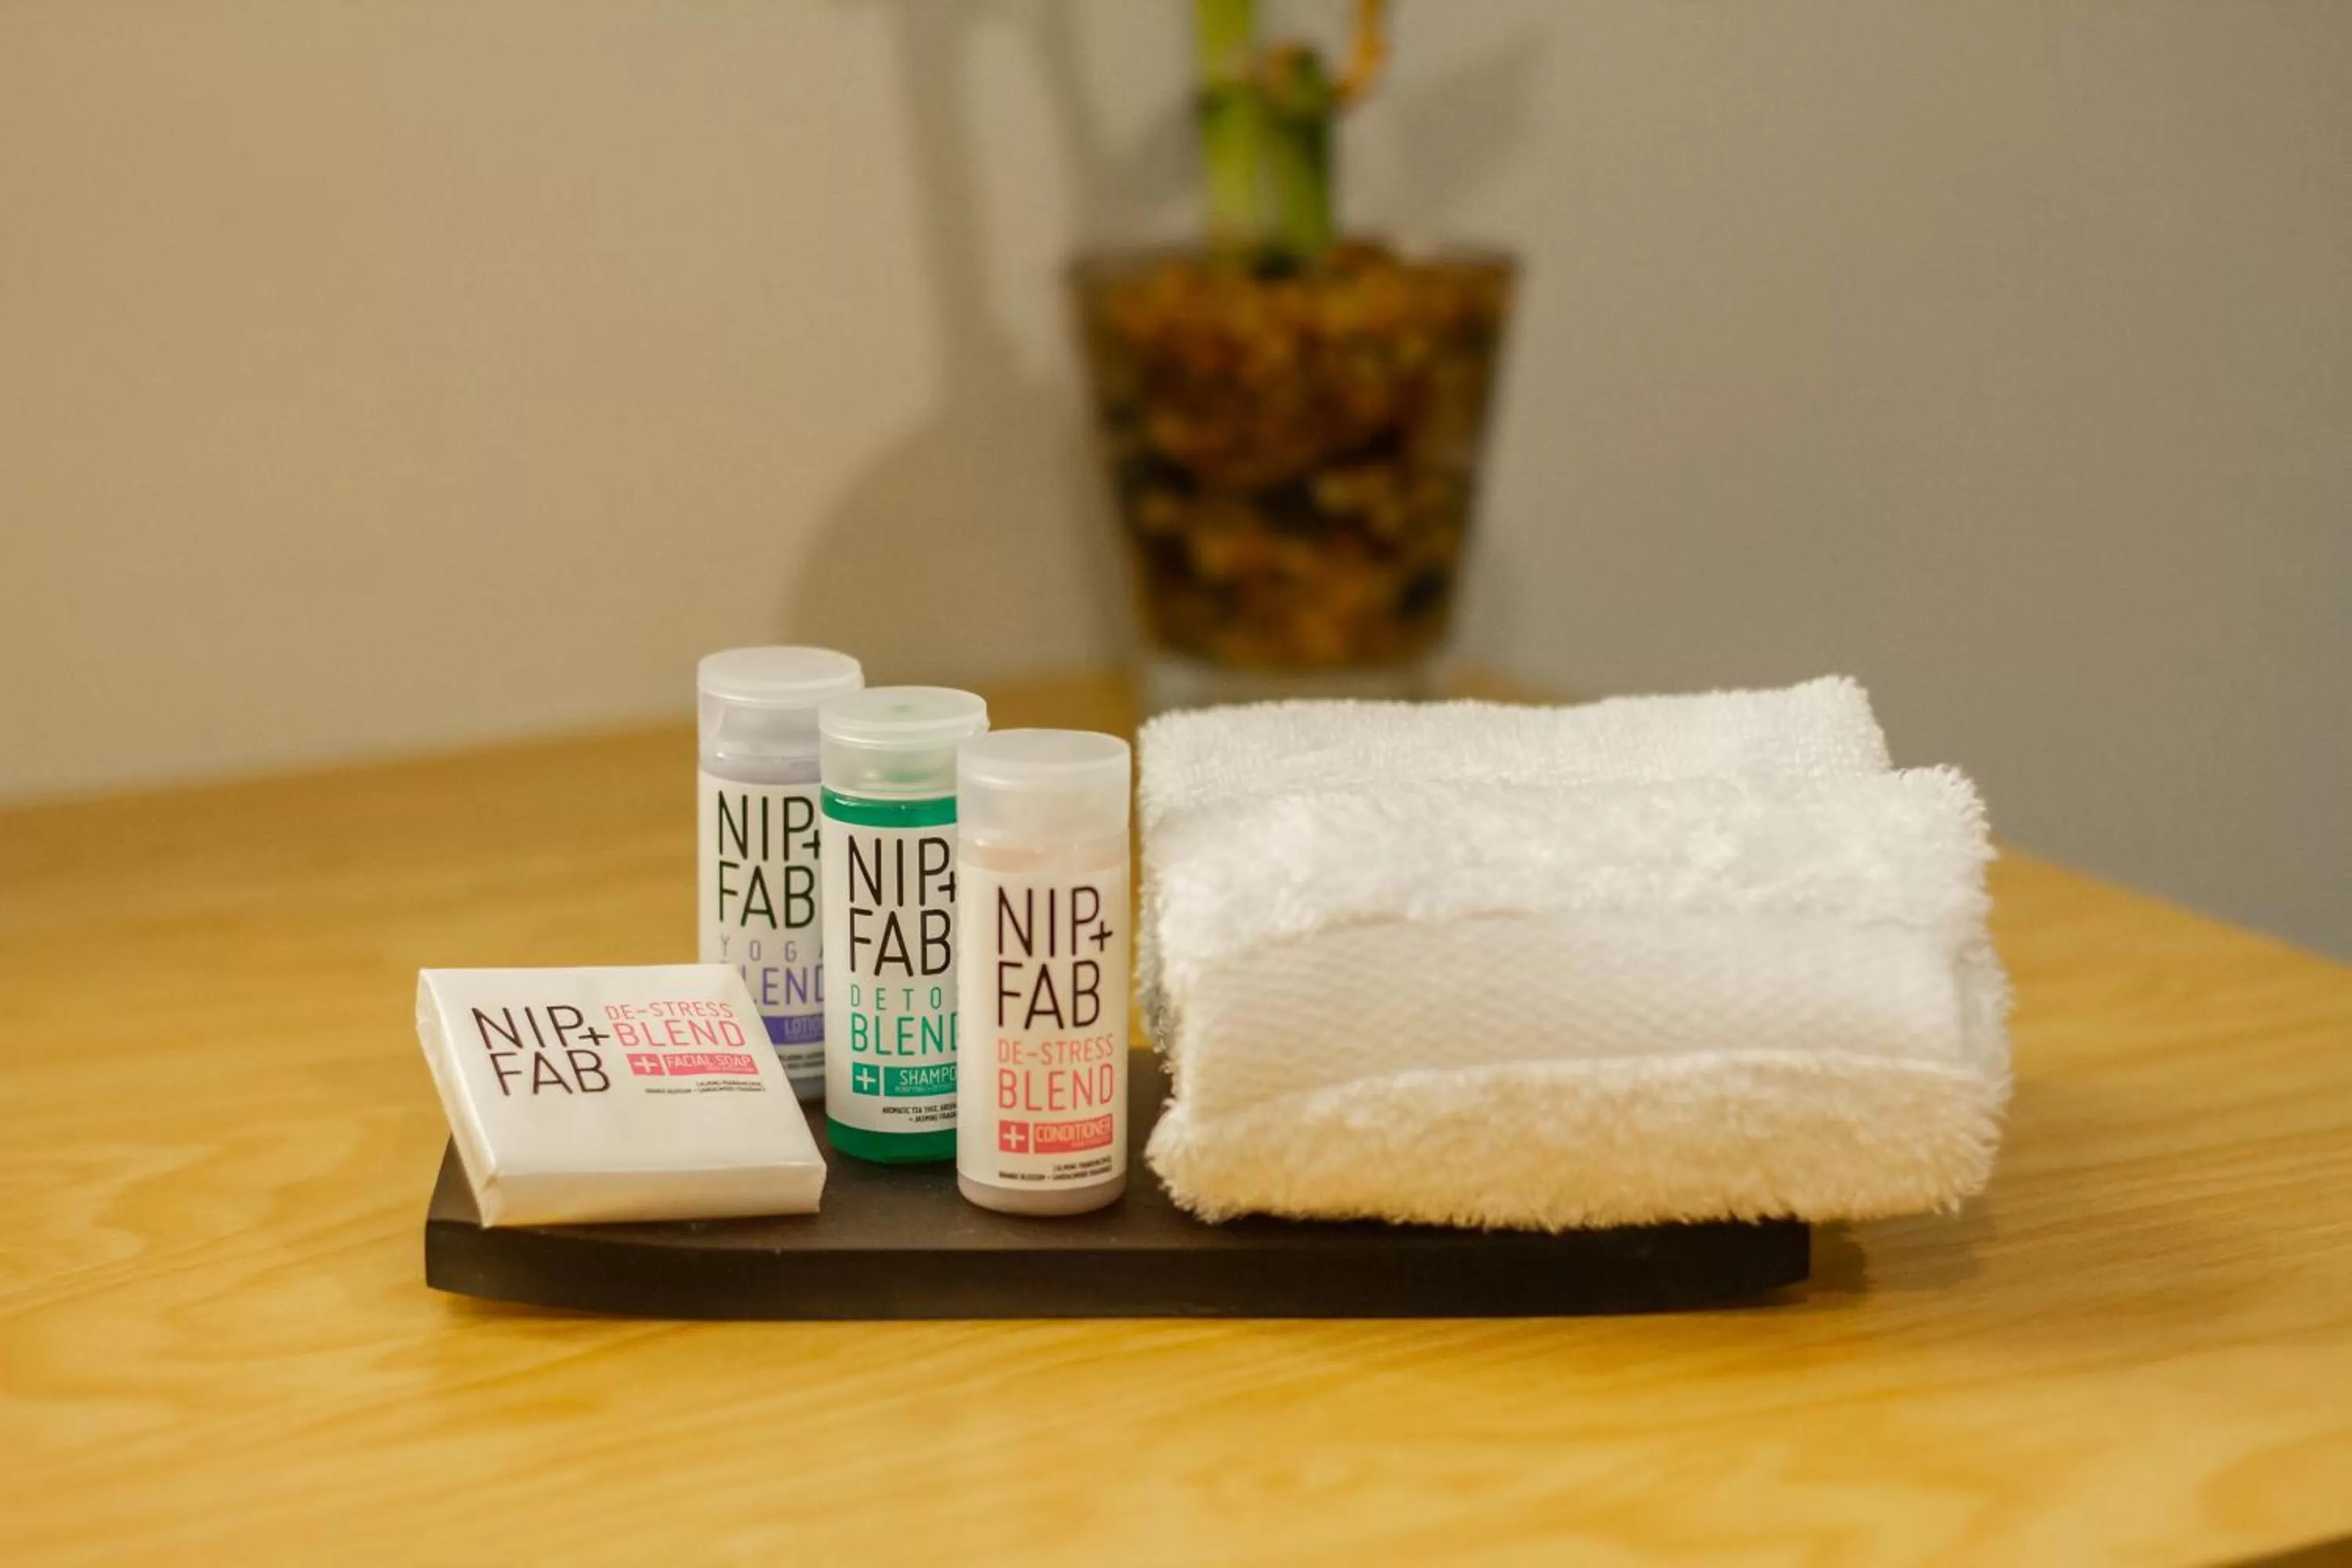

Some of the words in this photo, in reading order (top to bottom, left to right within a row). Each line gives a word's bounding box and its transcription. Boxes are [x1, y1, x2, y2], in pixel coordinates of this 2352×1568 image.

[719, 860, 815, 930] FAB
[998, 886, 1113, 957] NIP+
[720, 935, 823, 964] YOG
[849, 907, 951, 977] FAB
[604, 1000, 735, 1019] DE-STRESS
[851, 984, 942, 1011] DETO
[998, 960, 1100, 1030] FAB
[471, 1005, 610, 1049] NIP+
[613, 1019, 746, 1047] BLEND
[666, 1054, 711, 1067] FACIAL
[715, 1054, 752, 1067] SOAP
[998, 1033, 1113, 1065] DE-STRESS
[490, 1050, 610, 1096] FAB
[898, 1065, 956, 1086] SHAMPO
[999, 1062, 1113, 1111] BLEND
